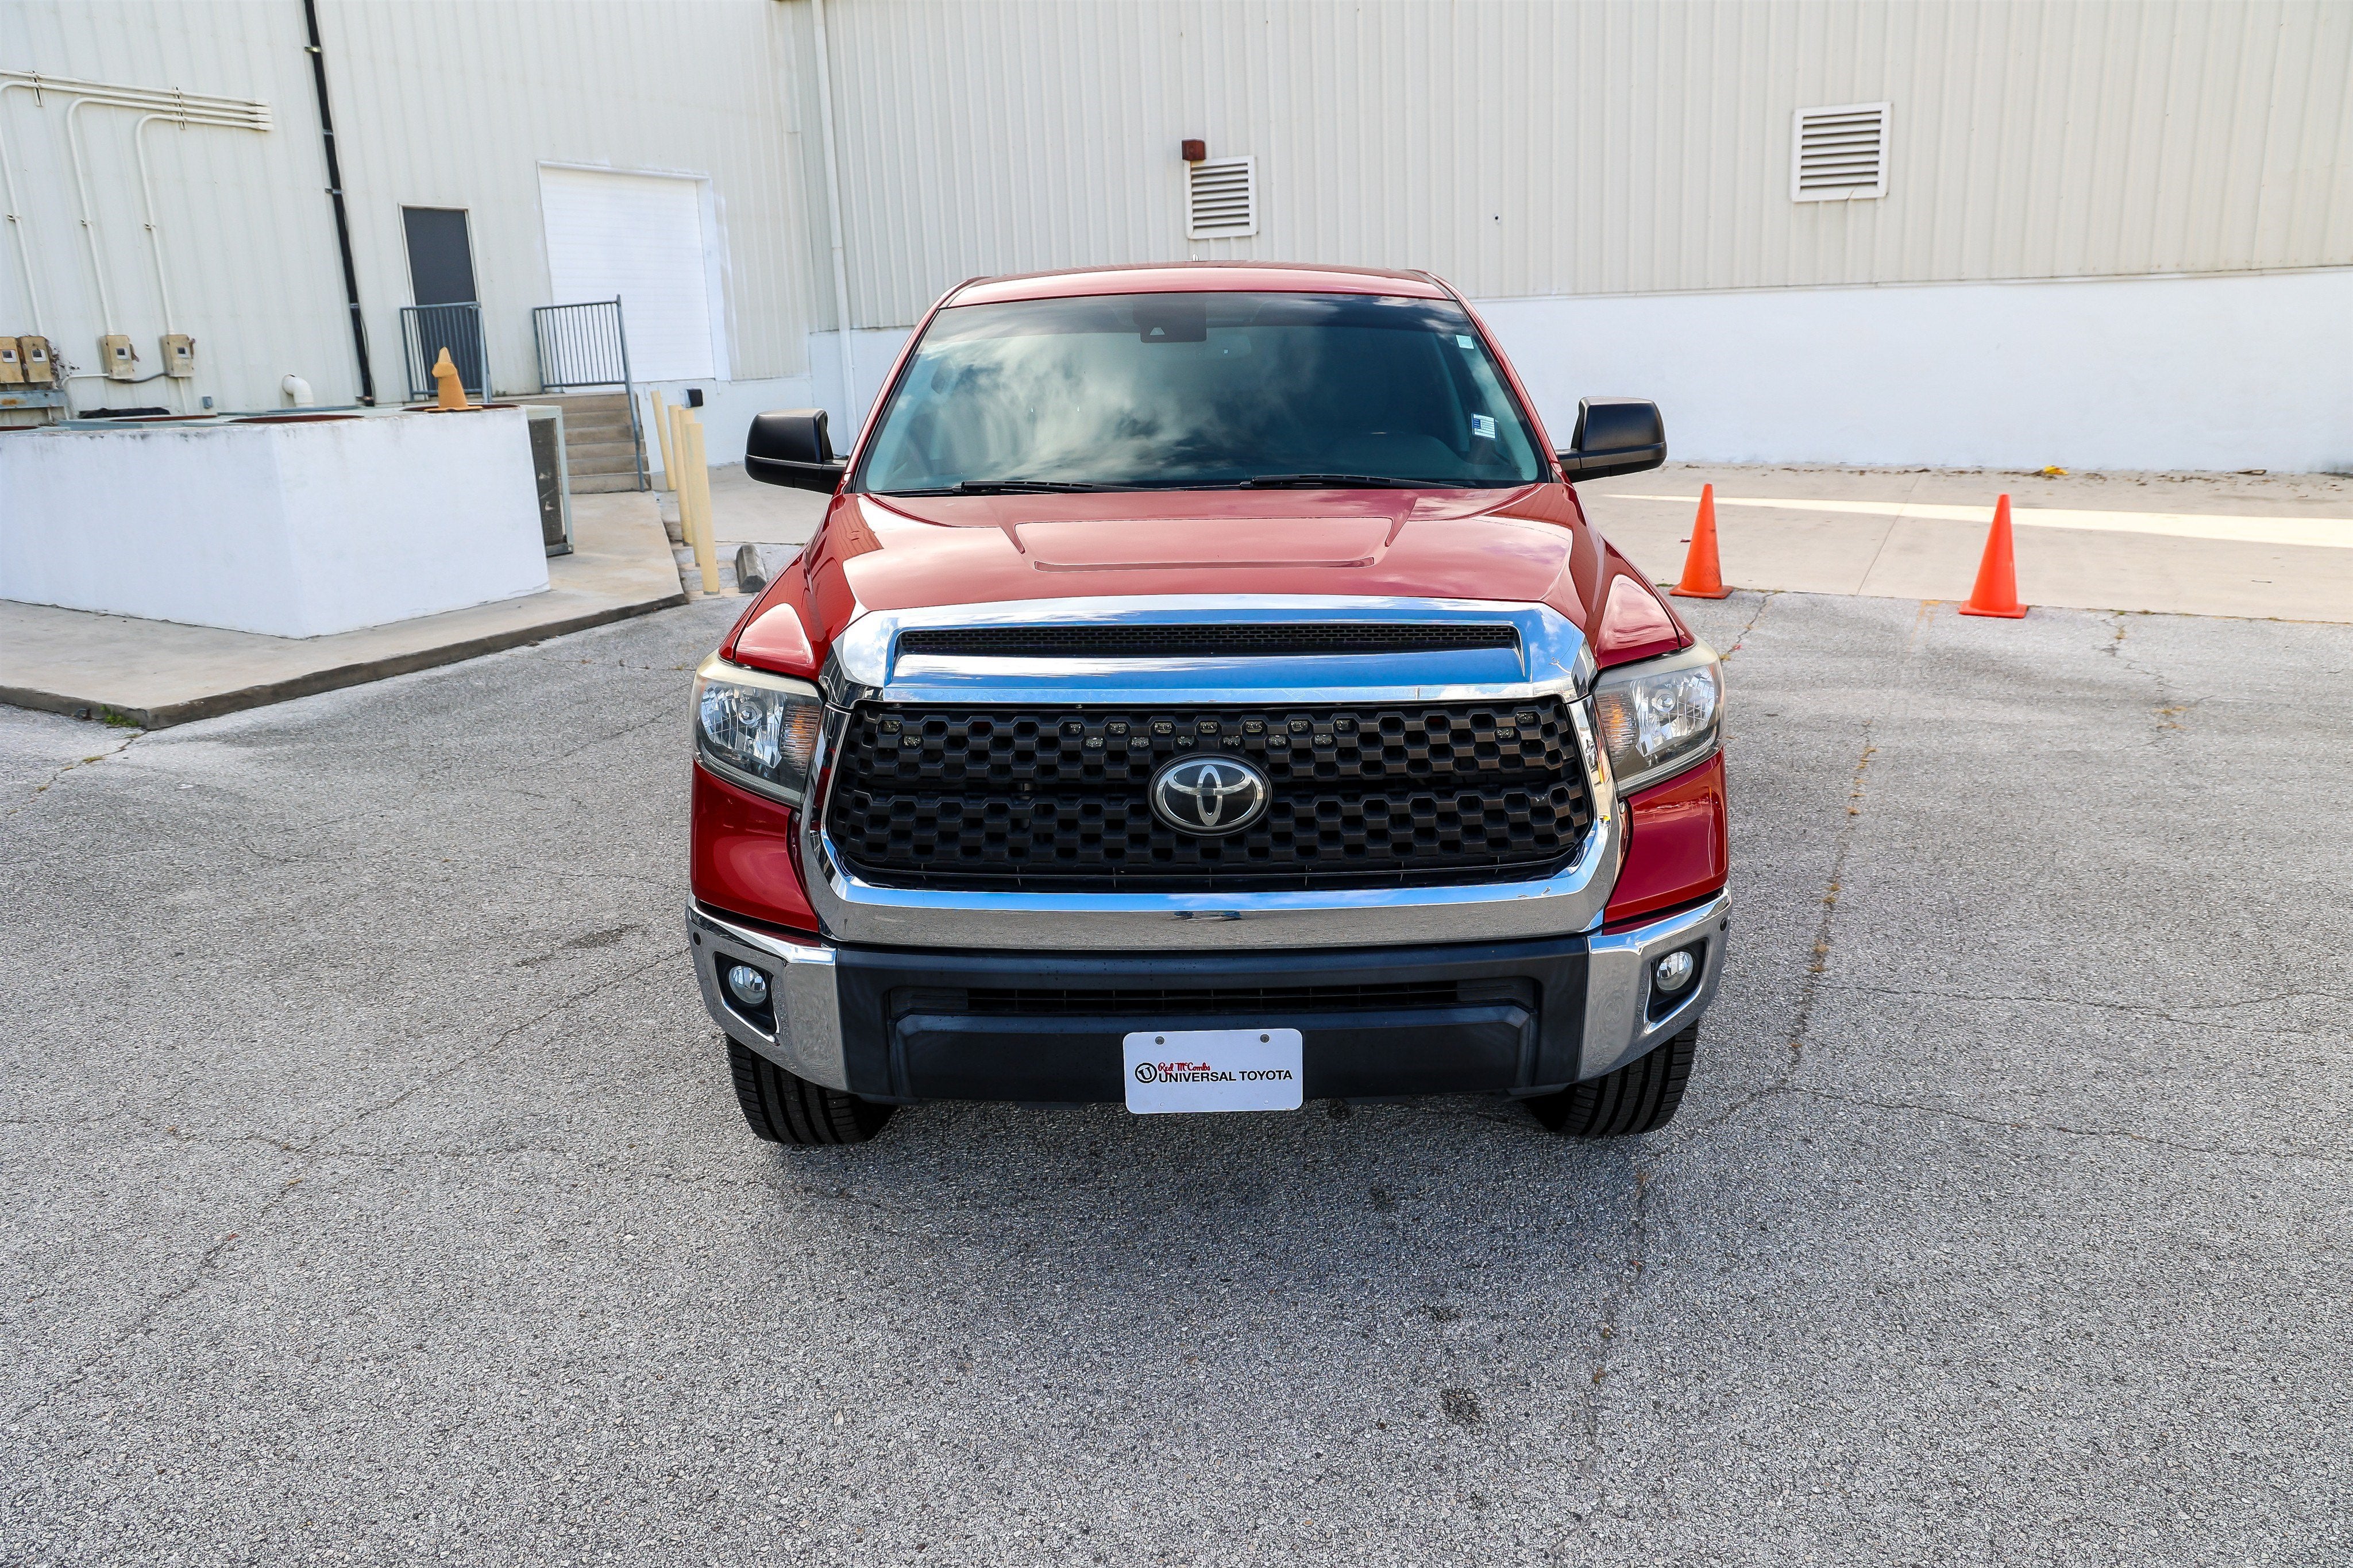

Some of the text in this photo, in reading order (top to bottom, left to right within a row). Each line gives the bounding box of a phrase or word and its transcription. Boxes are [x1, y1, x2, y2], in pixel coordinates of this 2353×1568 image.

[1158, 1062, 1210, 1075] Red McCombs
[1159, 1070, 1293, 1083] UNIVERSAL TOYOTA
